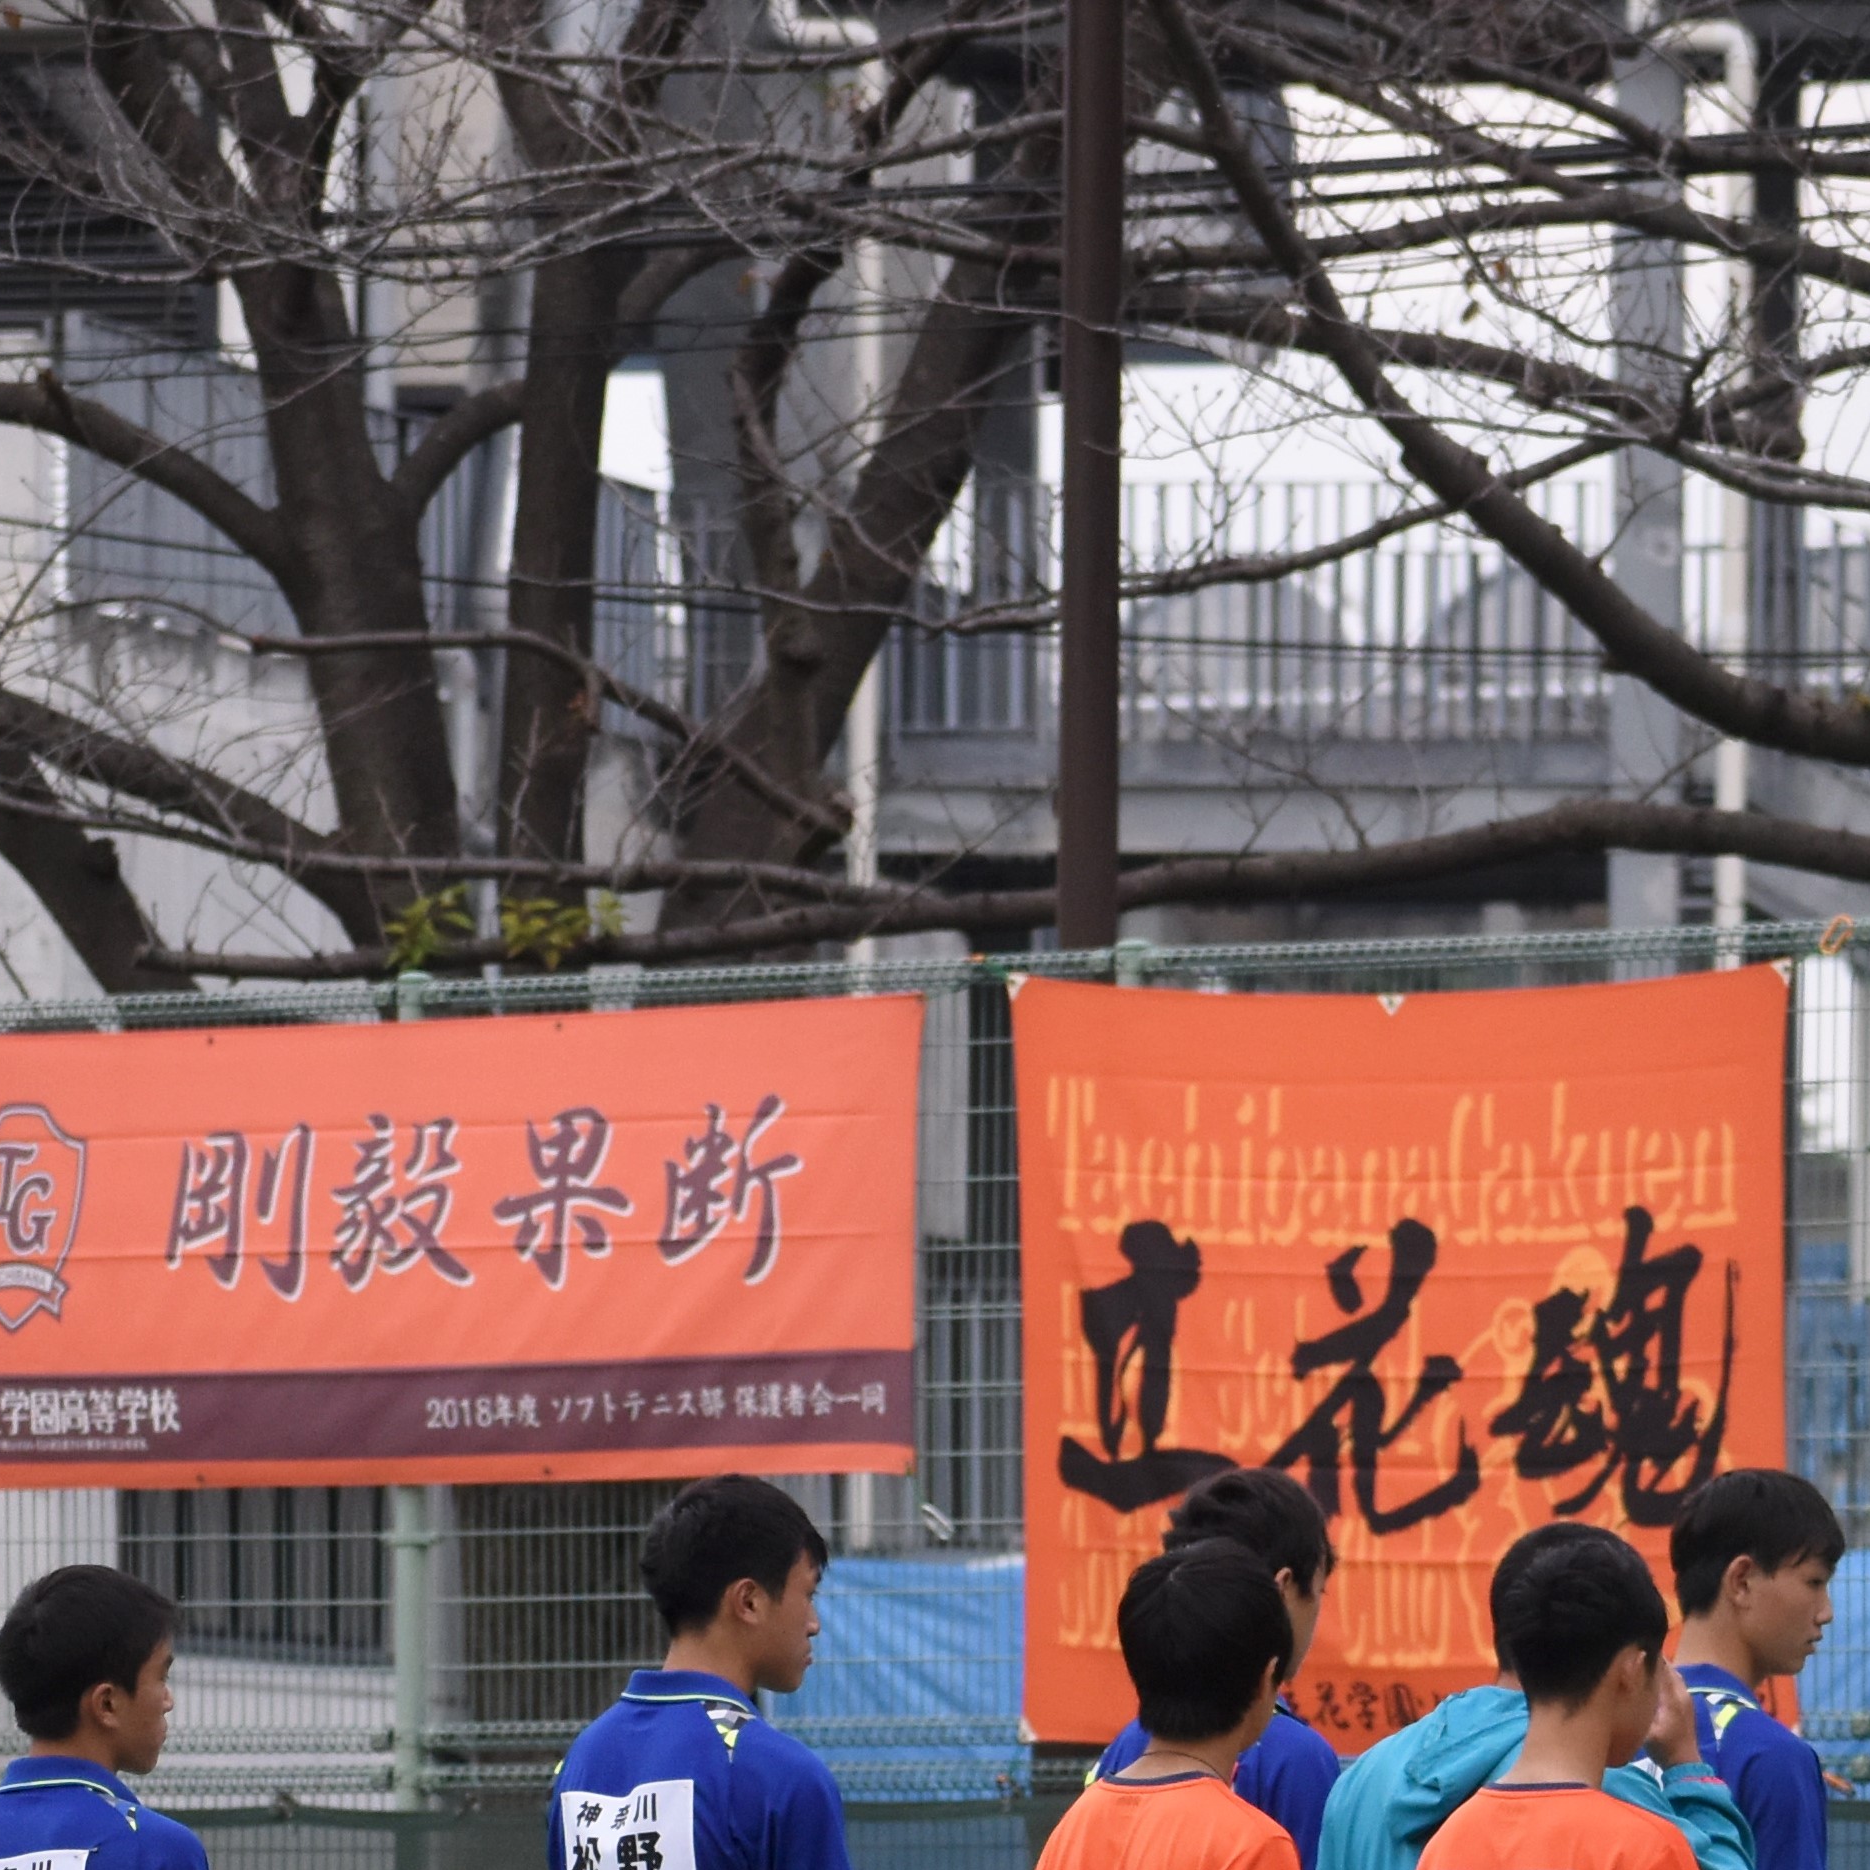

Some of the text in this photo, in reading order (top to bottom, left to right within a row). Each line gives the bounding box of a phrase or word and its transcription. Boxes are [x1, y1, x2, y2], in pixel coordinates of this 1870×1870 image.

[165, 1093, 805, 1301] 剛毅果断
[426, 1381, 887, 1430] 2018年度 ソフトテニス部 保護者会一同
[1057, 1206, 1740, 1537] 立花魂
[577, 1793, 657, 1831] 神奈川
